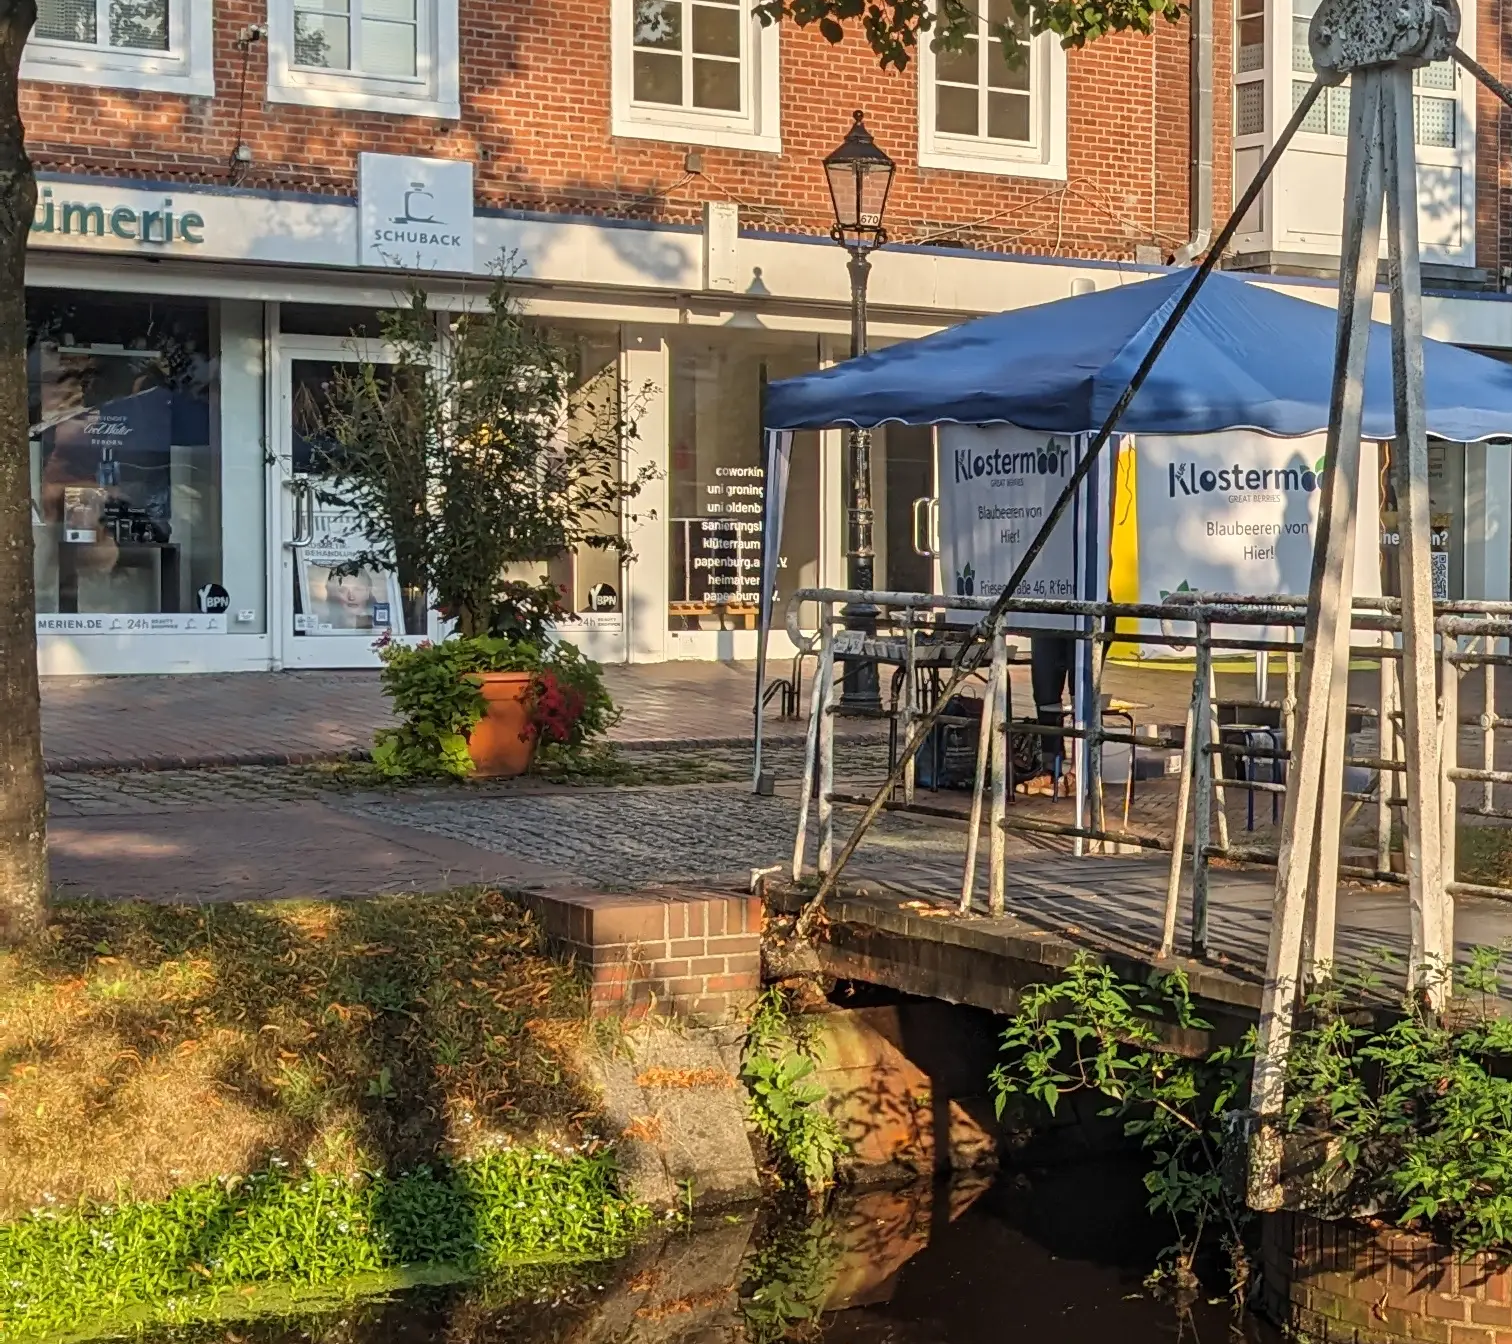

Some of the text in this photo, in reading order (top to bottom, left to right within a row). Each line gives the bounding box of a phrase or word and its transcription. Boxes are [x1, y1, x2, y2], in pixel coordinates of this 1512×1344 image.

[860, 214, 879, 224] 670
[374, 229, 461, 246] SCHUBACK
[715, 465, 764, 477] coworkin
[955, 448, 1069, 484] Klostermoor
[707, 483, 724, 494] uni
[1228, 495, 1281, 504] GREAT BERRIES
[707, 501, 762, 513] uni oldenb
[978, 505, 1042, 520] Blaubeeren von
[1206, 521, 1309, 536] Blaubeeren von
[1000, 529, 1020, 544] Hier!
[1243, 546, 1275, 560] Hier!
[694, 556, 761, 570] papenburg.a
[708, 574, 761, 586] heimatver
[1033, 580, 1047, 597] 46,
[703, 591, 760, 604] papenburg
[127, 618, 149, 630] 24h
